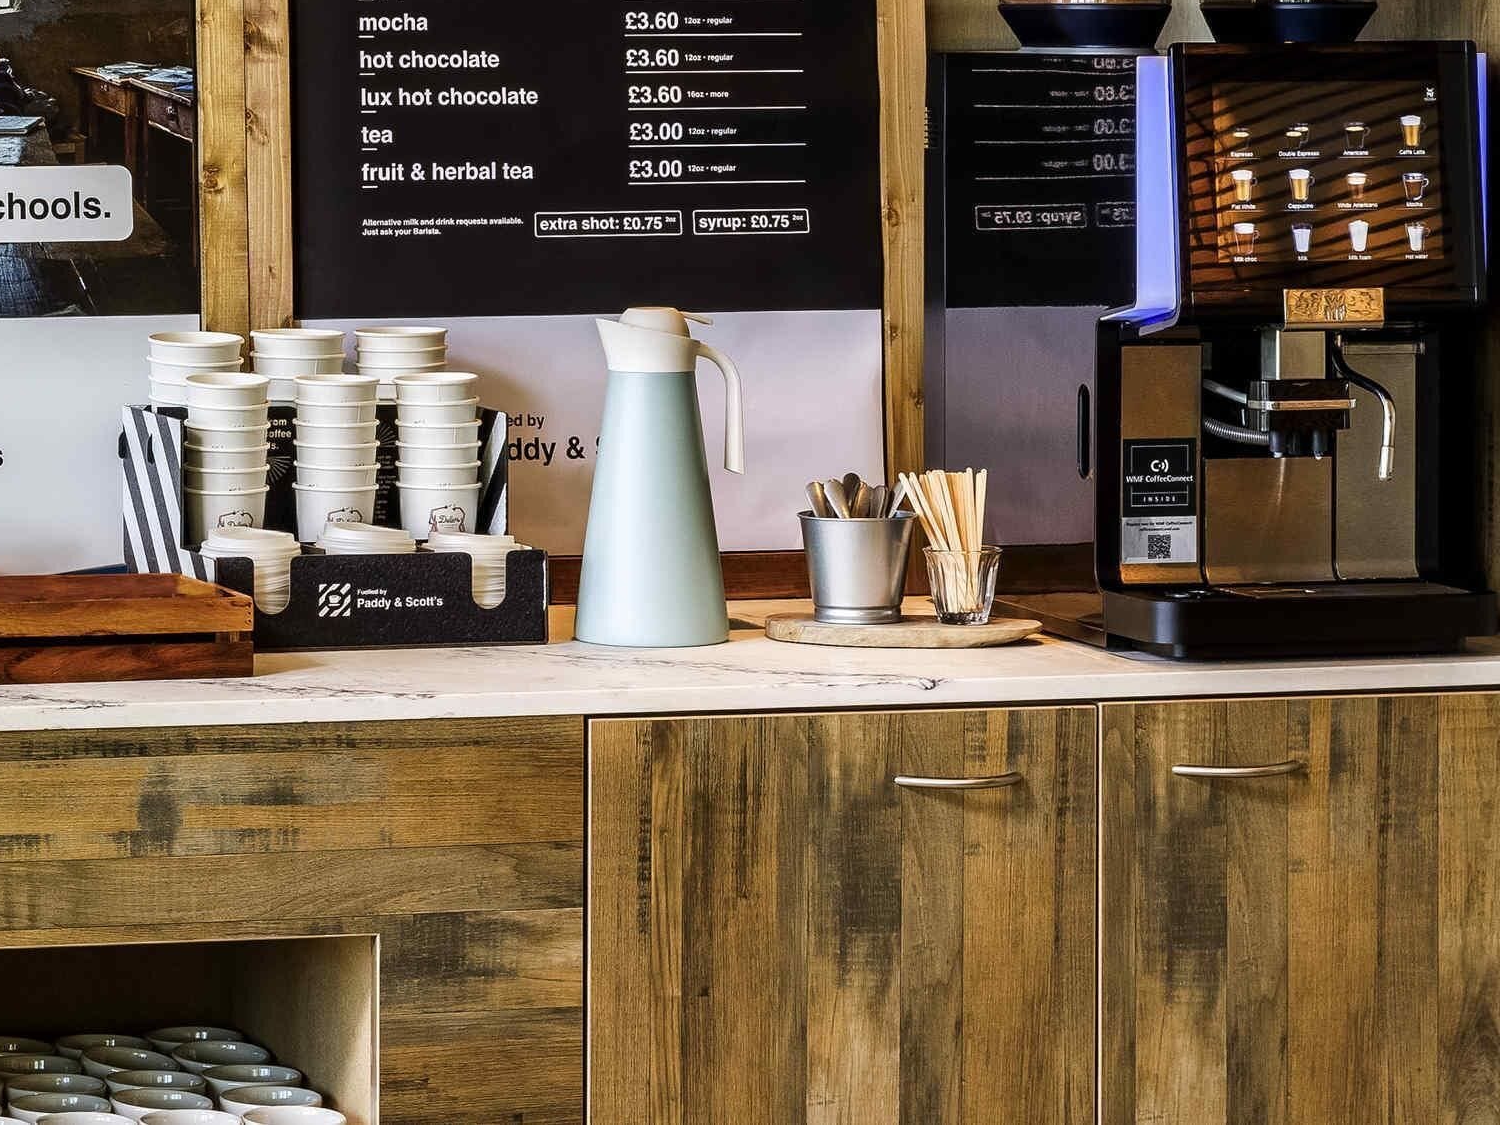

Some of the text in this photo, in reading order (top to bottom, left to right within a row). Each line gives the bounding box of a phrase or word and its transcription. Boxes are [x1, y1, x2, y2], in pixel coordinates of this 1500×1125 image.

[359, 12, 679, 31] mocha £3.60
[360, 49, 679, 68] hot chocolate £3.60
[361, 86, 682, 106] lux hot chocolate £3.60
[361, 122, 683, 143] tea £3.00
[361, 160, 682, 181] fruit & herbal tea £3.00
[540, 216, 663, 231] extra shot: £0.75
[699, 215, 790, 230] syrup: £0.75
[527, 414, 544, 430] by
[267, 429, 292, 439] offee
[508, 433, 556, 466] ddy
[566, 436, 585, 459] &
[1126, 475, 1143, 483] WMF
[357, 596, 443, 610] Paddy & Scott's
